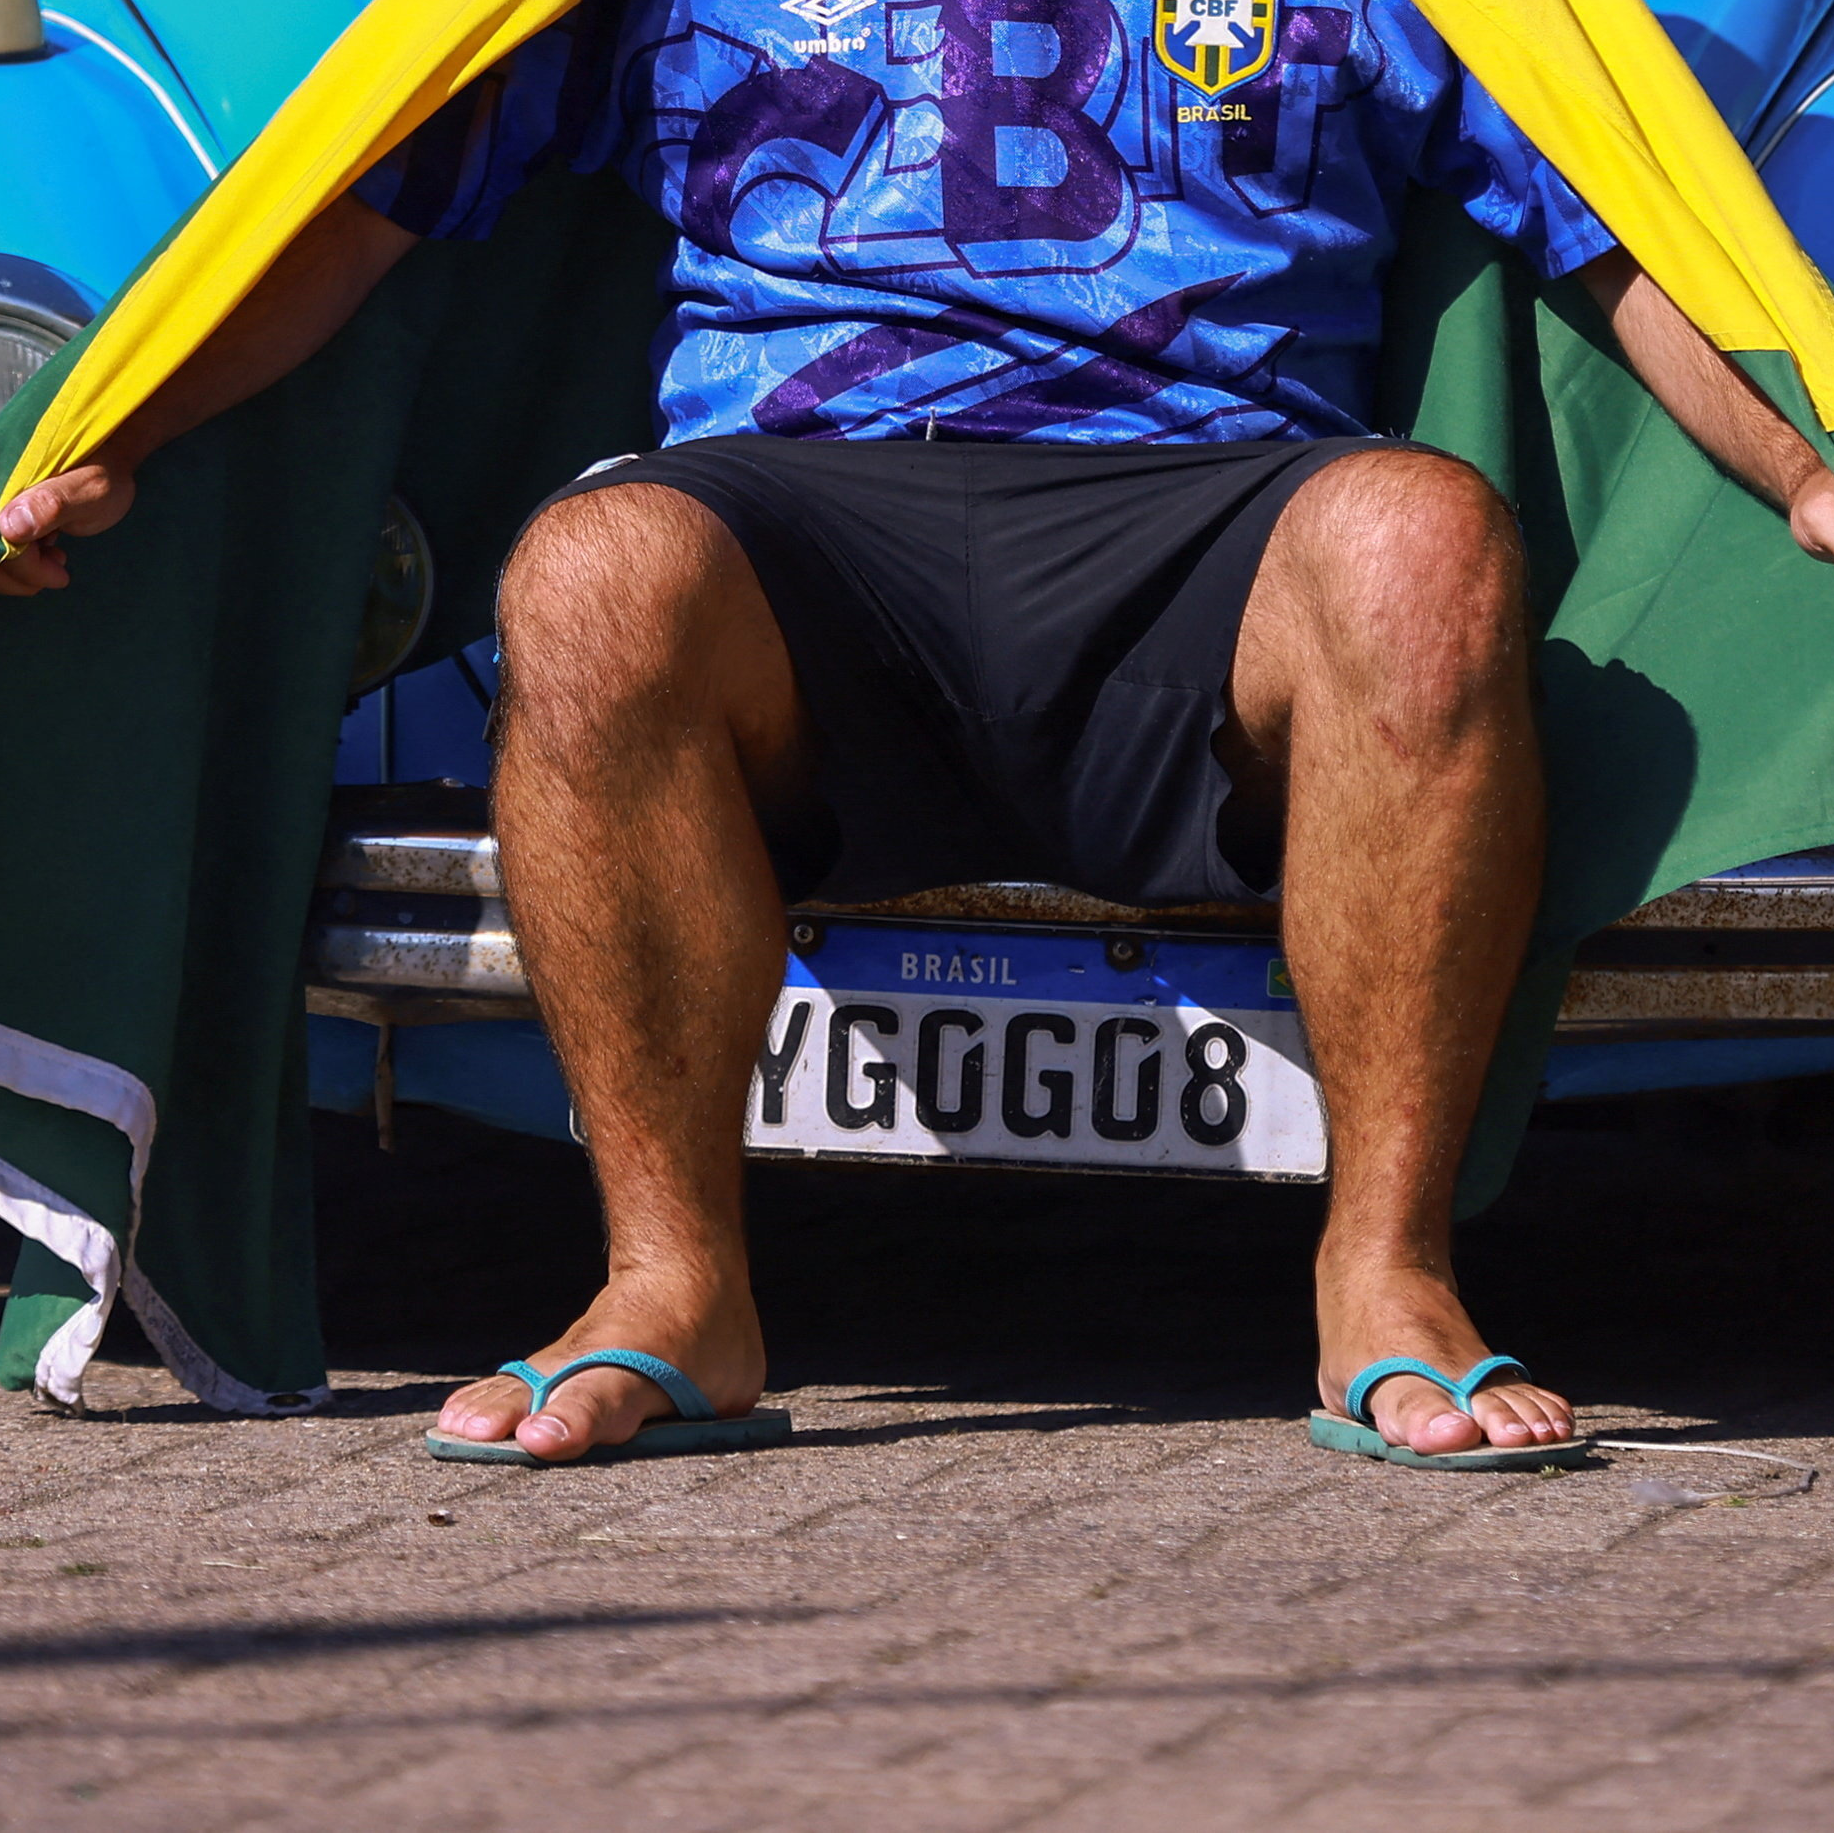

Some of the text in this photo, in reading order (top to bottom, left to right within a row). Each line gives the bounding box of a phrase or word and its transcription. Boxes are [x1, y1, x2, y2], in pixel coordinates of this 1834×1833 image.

[793, 32, 866, 54] umbro
[1177, 104, 1252, 123] BRASIL
[901, 952, 1017, 985] BRASIL
